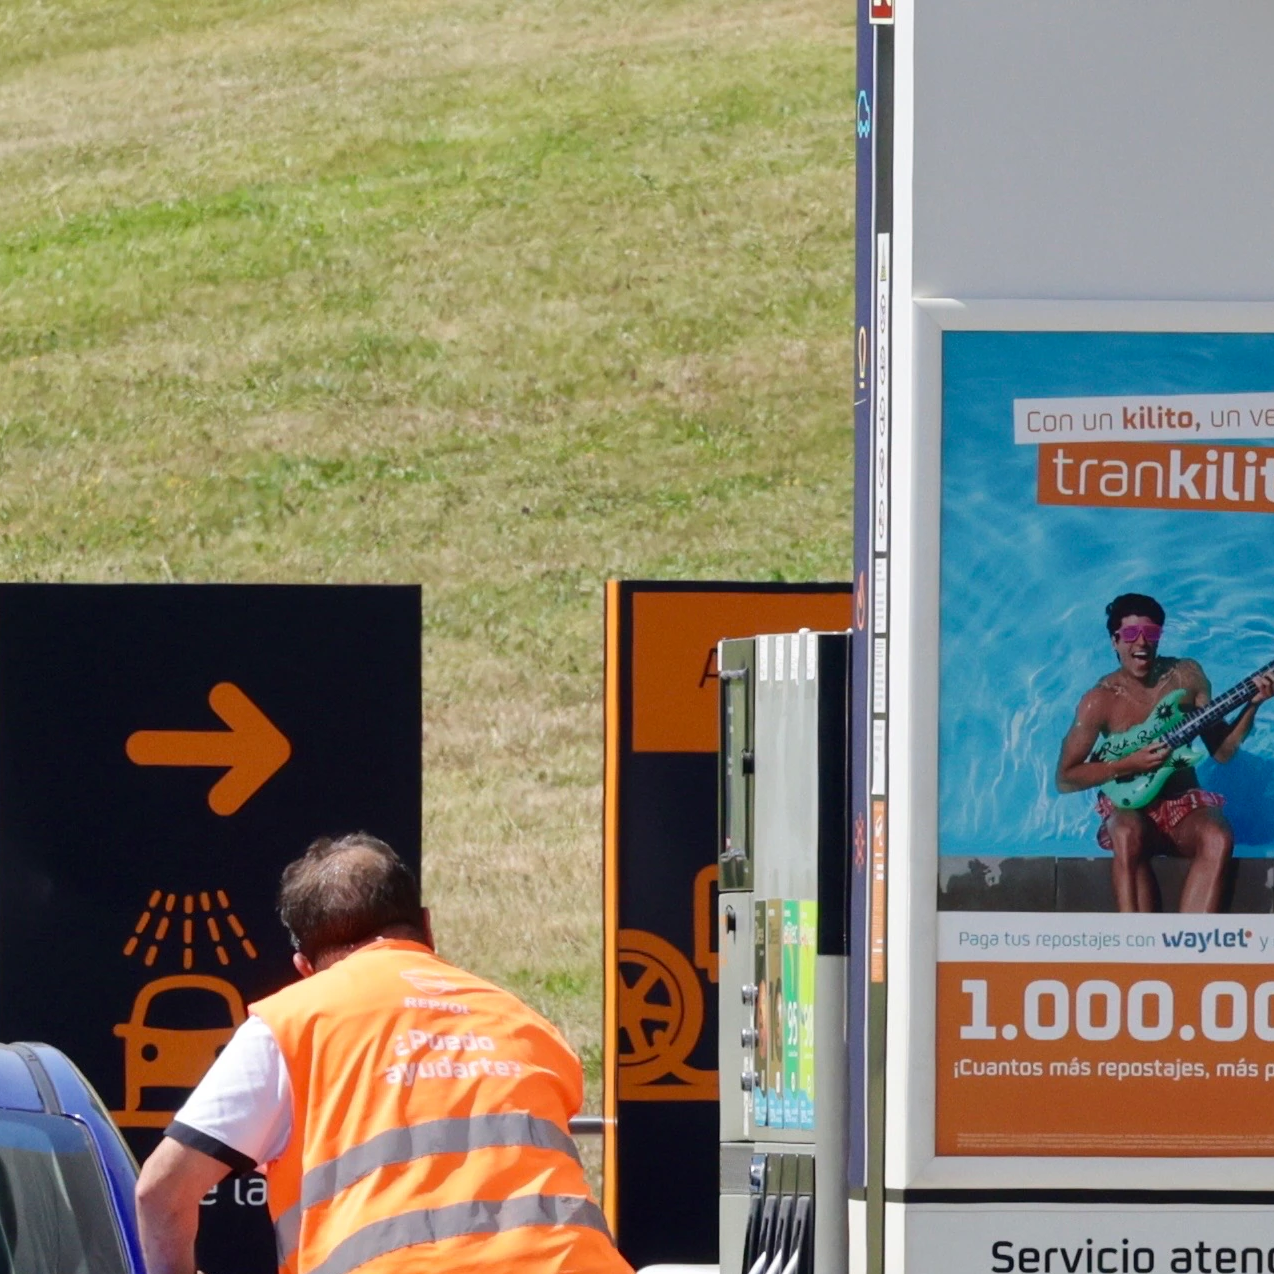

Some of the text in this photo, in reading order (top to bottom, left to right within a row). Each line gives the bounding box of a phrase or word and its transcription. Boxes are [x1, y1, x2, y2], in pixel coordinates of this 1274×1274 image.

[1025, 410, 1074, 432] Con
[1083, 410, 1114, 431] un
[1121, 405, 1202, 433] kilito,
[1211, 407, 1242, 428] un
[958, 930, 1000, 951] Paga
[1004, 933, 1031, 949] tus
[1035, 930, 1122, 951] repostajes
[1125, 934, 1156, 948] con
[1161, 927, 1253, 953] waylet
[1259, 935, 1270, 952] y
[953, 1058, 1043, 1079] ¡Cuantos
[1049, 1058, 1091, 1077] más
[1097, 1058, 1211, 1081] repostajes,
[1216, 1058, 1259, 1077] más
[991, 1238, 1155, 1274] Servicio
